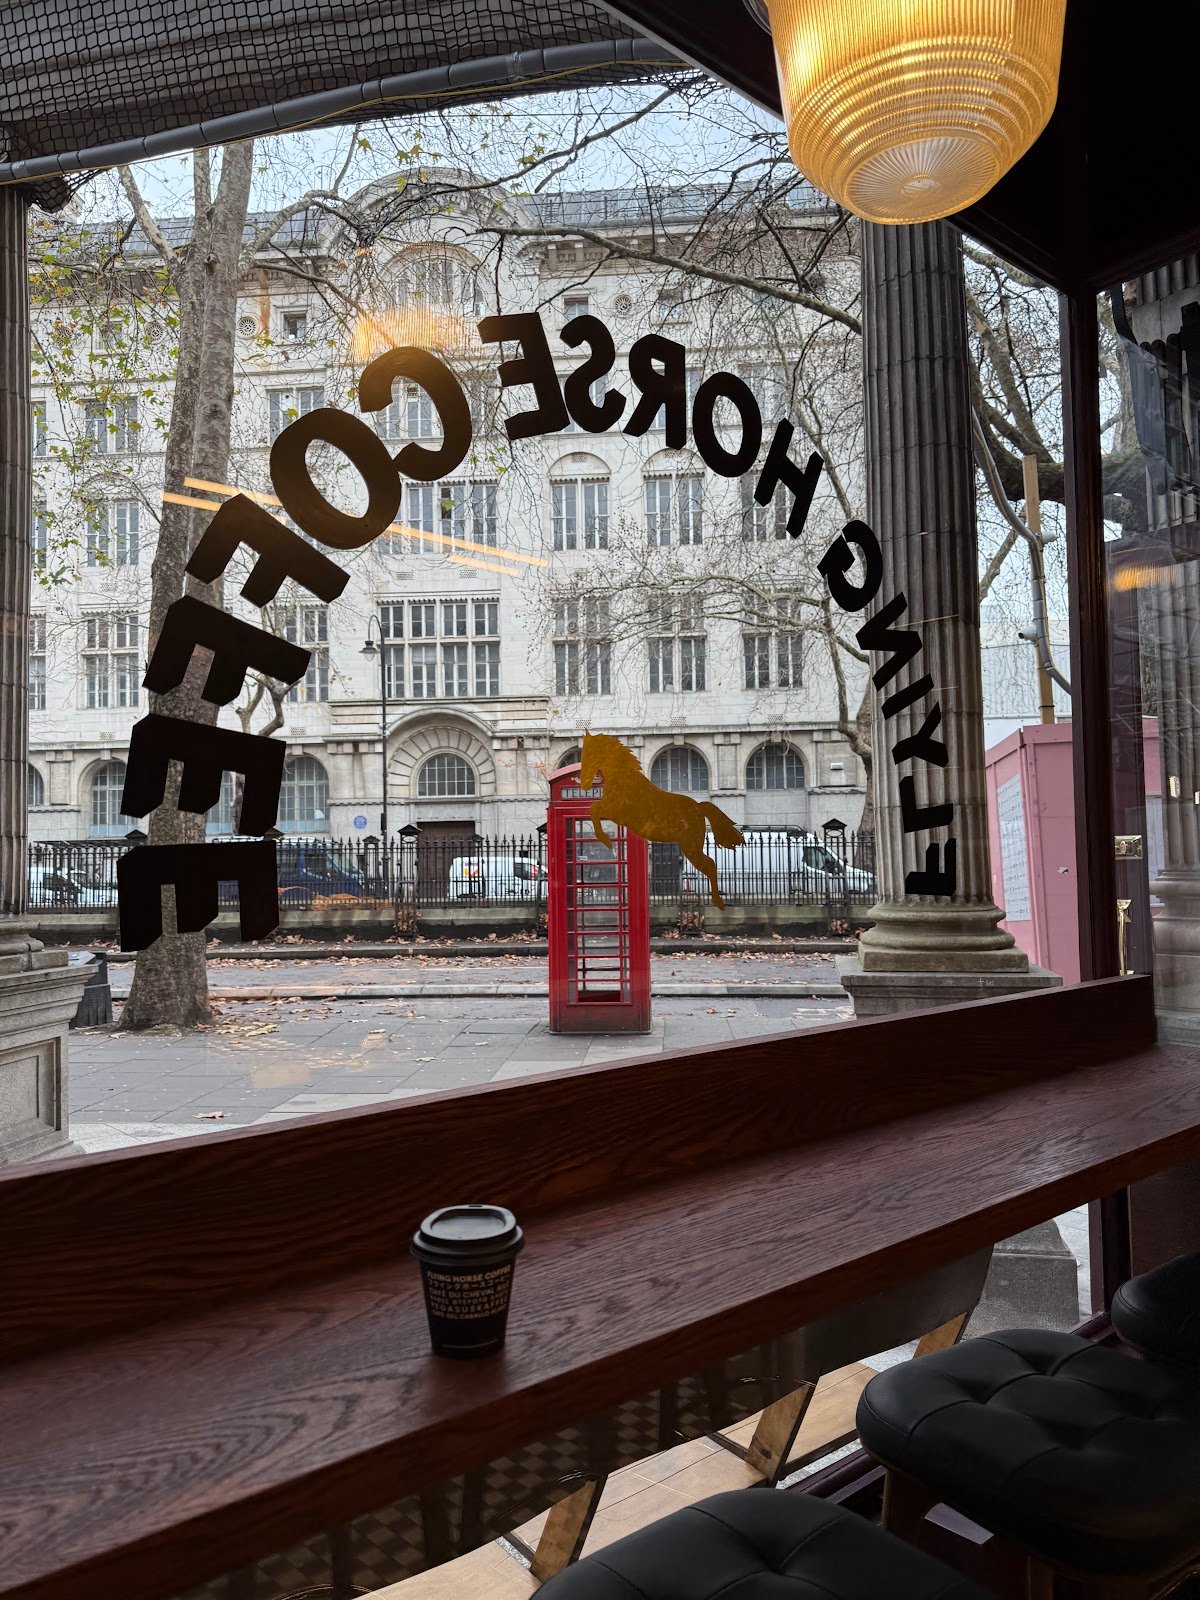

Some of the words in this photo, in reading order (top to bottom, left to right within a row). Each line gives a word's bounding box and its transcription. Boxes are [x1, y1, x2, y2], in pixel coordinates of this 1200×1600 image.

[565, 788, 603, 798] TELEP
[427, 1271, 451, 1282] FLYING
[453, 1274, 483, 1282] HORSE
[485, 1265, 511, 1279] COFFEE
[463, 1288, 495, 1298] CHEVAL
